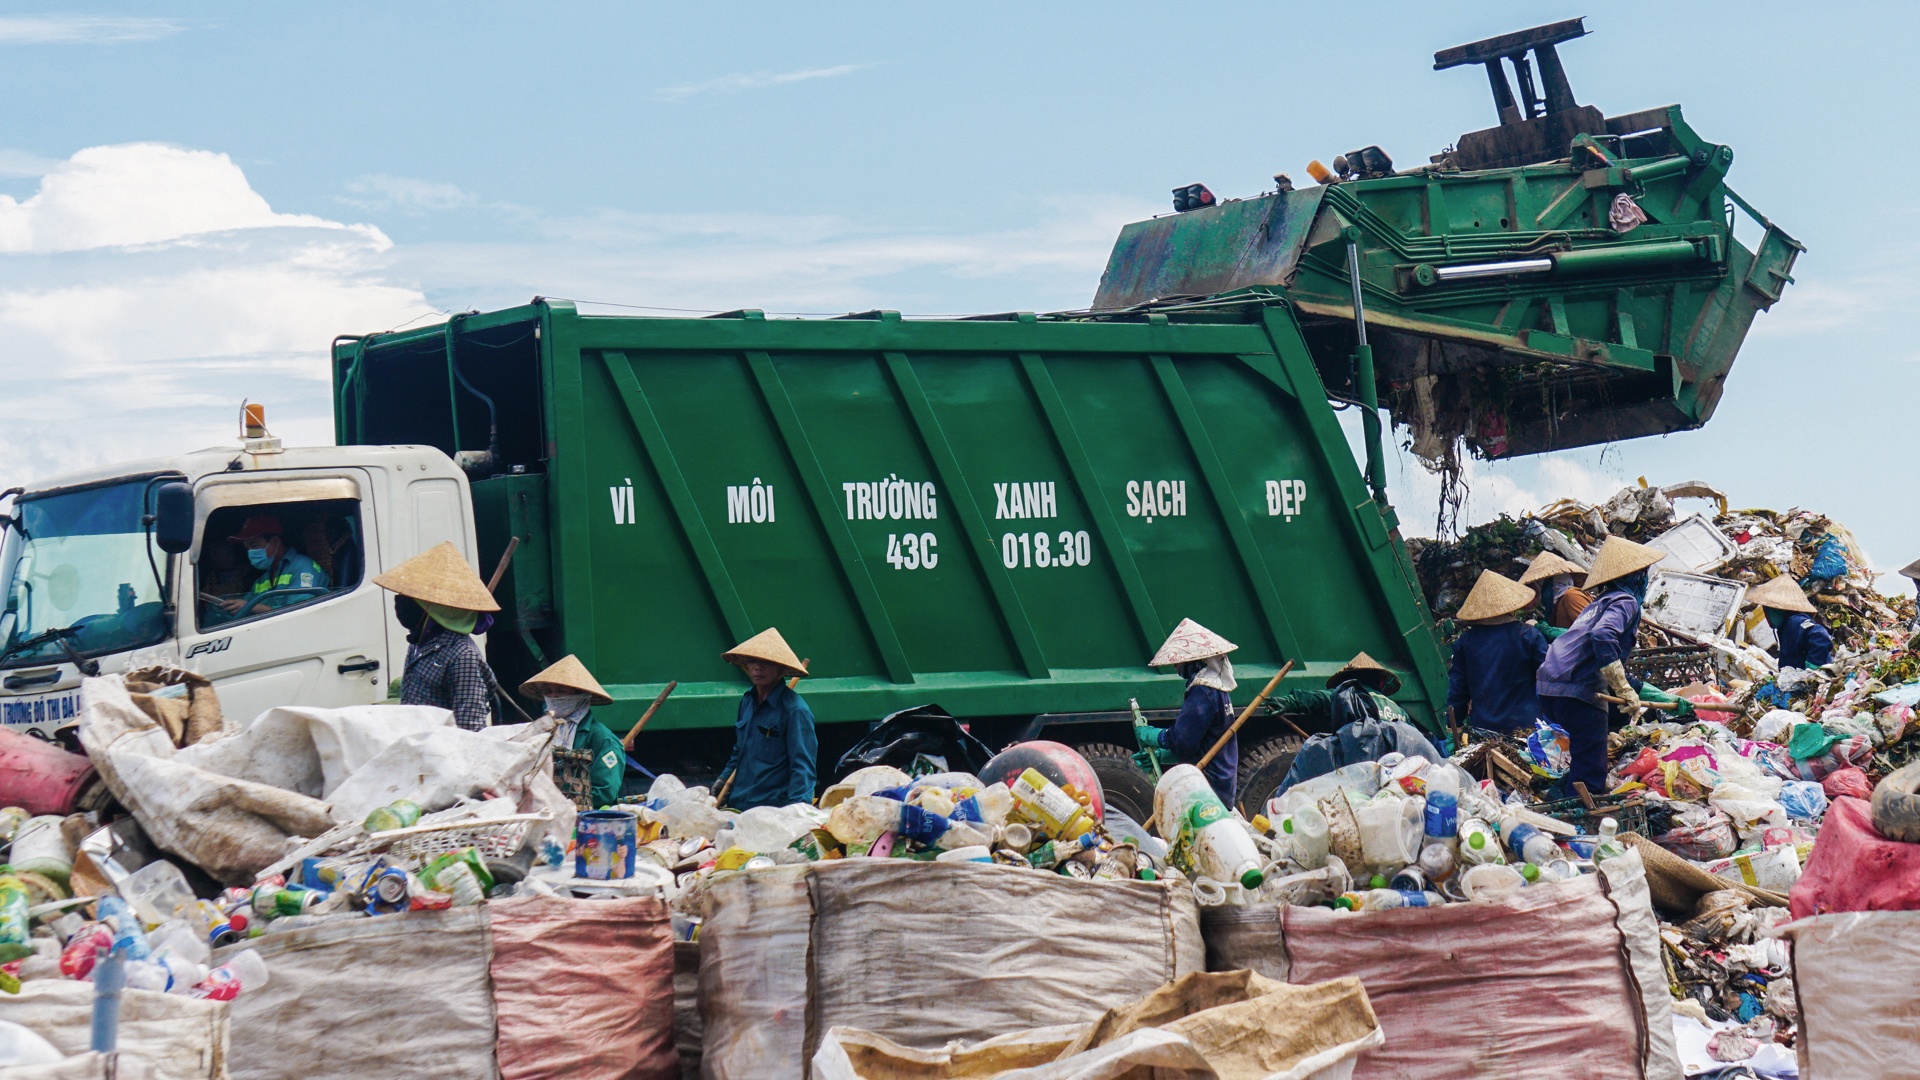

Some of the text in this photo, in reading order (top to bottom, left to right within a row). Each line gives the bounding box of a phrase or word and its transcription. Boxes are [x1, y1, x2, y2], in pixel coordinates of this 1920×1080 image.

[609, 473, 1307, 525] VÌ MÔI TRƯỜNG XANH SẠCH ĐẸP
[886, 530, 1091, 570] 43C 018.30
[185, 636, 232, 659] FM
